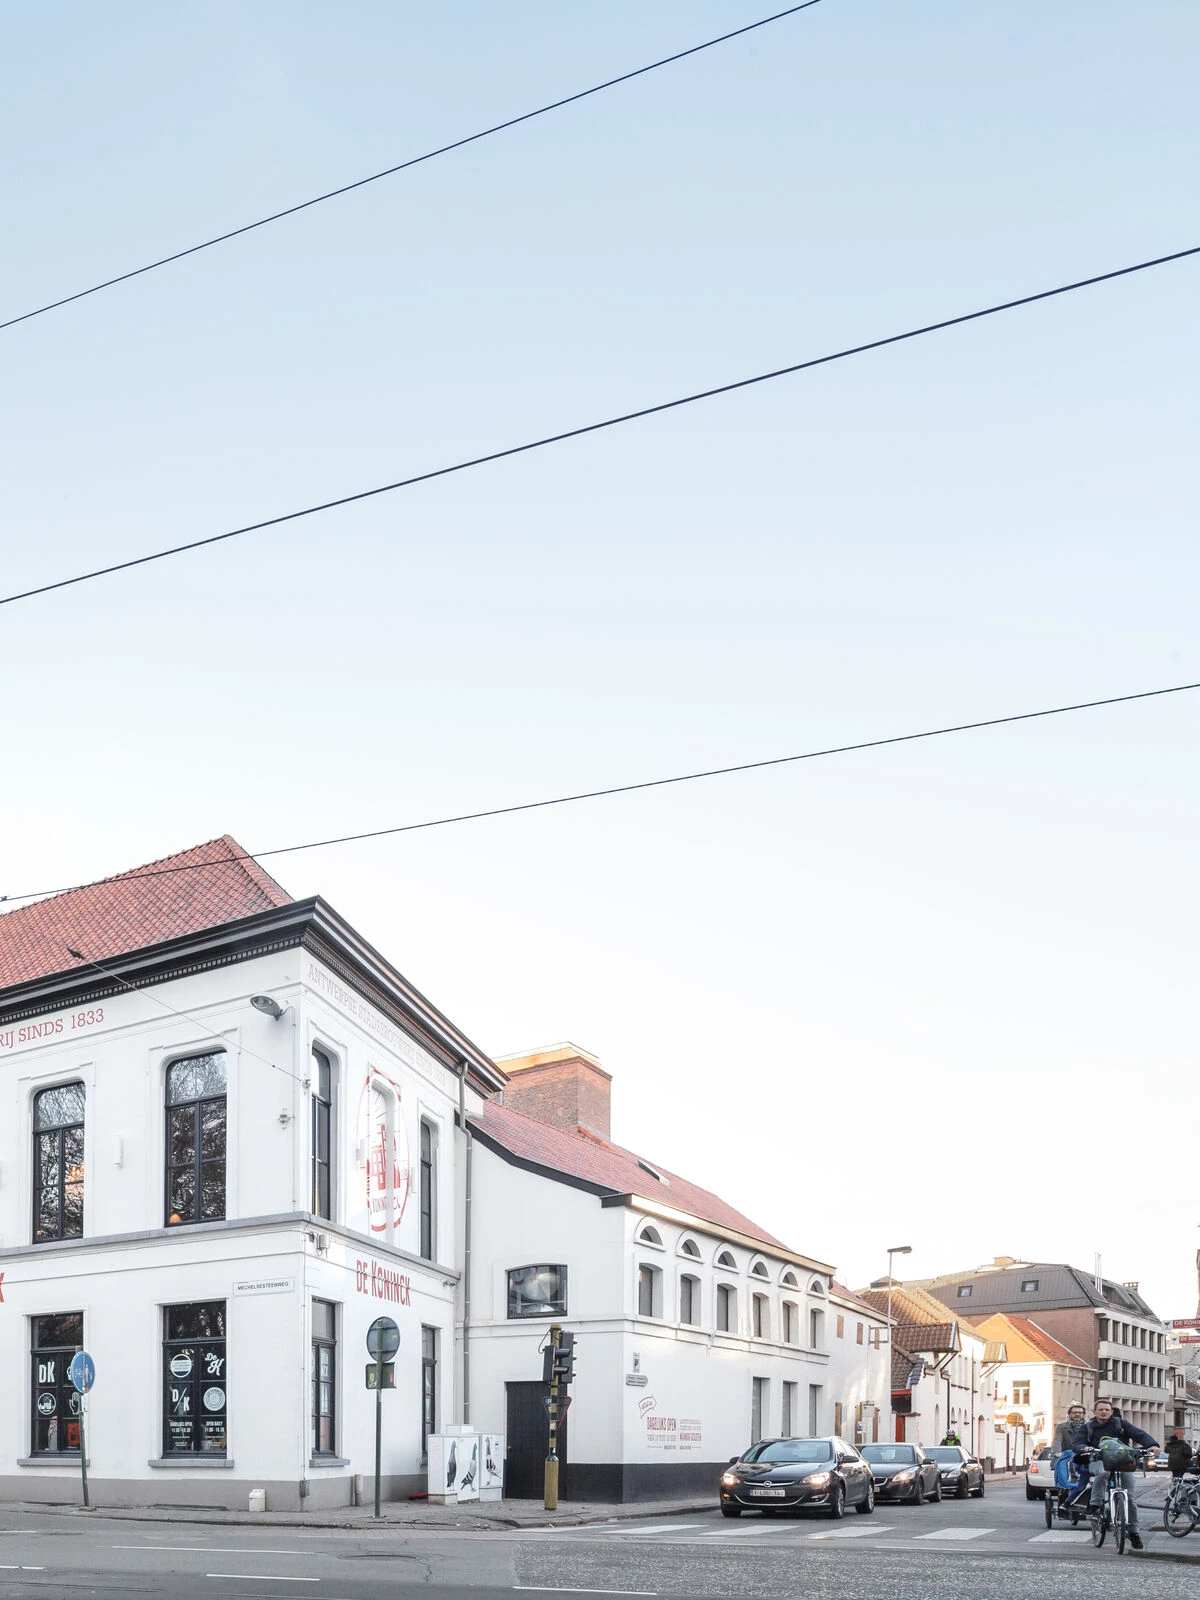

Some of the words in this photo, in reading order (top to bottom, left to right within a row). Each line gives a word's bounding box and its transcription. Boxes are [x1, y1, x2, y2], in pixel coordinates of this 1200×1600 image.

[18, 1018, 64, 1043] SINDS
[71, 1008, 104, 1030] 1833
[238, 1282, 288, 1290] MECHELSESTEENWEG
[357, 1260, 368, 1294] DE
[372, 1260, 410, 1307] KONINCK
[205, 1352, 218, 1360] De
[38, 1361, 55, 1383] DK
[208, 1358, 224, 1376] K
